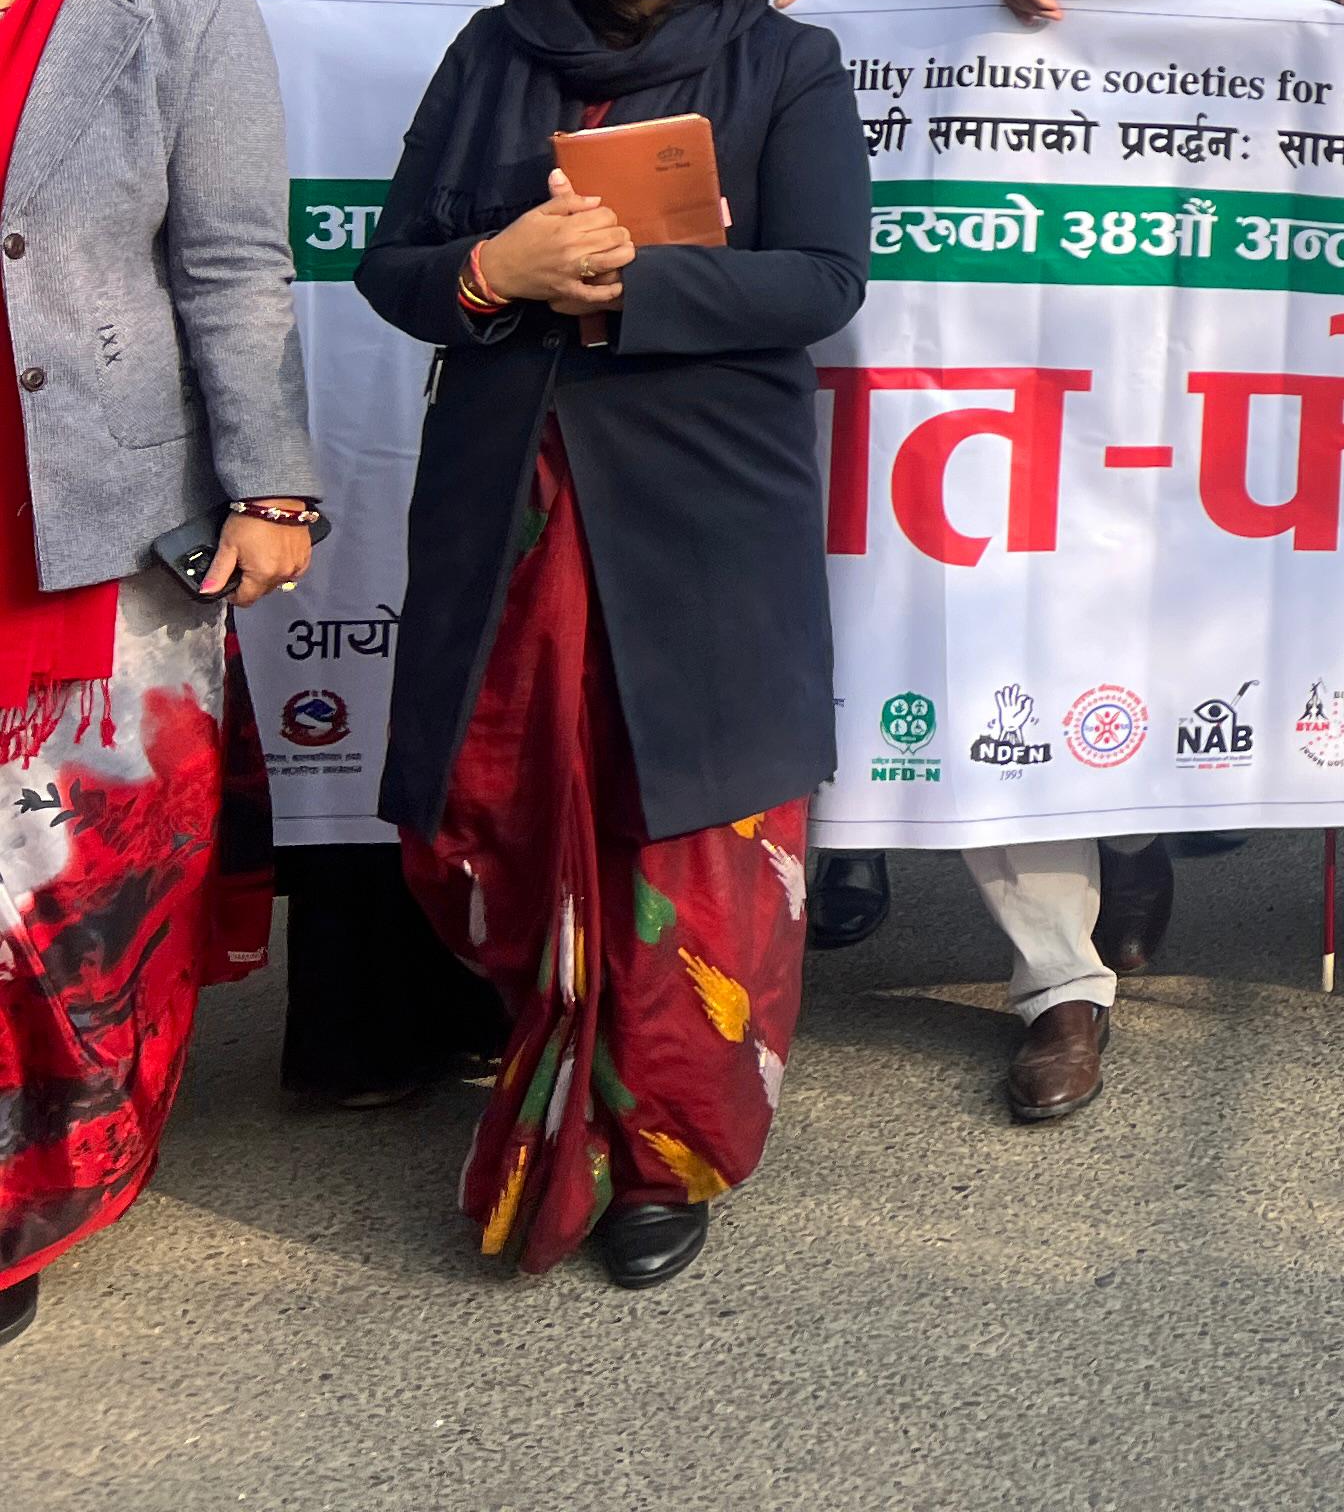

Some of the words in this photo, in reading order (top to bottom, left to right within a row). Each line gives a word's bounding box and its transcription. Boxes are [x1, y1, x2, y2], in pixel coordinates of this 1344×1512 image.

[924, 55, 1091, 92] inclusive
[1102, 64, 1265, 101] societies
[1277, 70, 1329, 105] for
[929, 110, 1098, 158] समाजको
[871, 193, 1044, 254] हरूको
[980, 743, 1045, 764] NDFN
[1176, 725, 1254, 754] NAB
[871, 767, 941, 782] NFD-N
